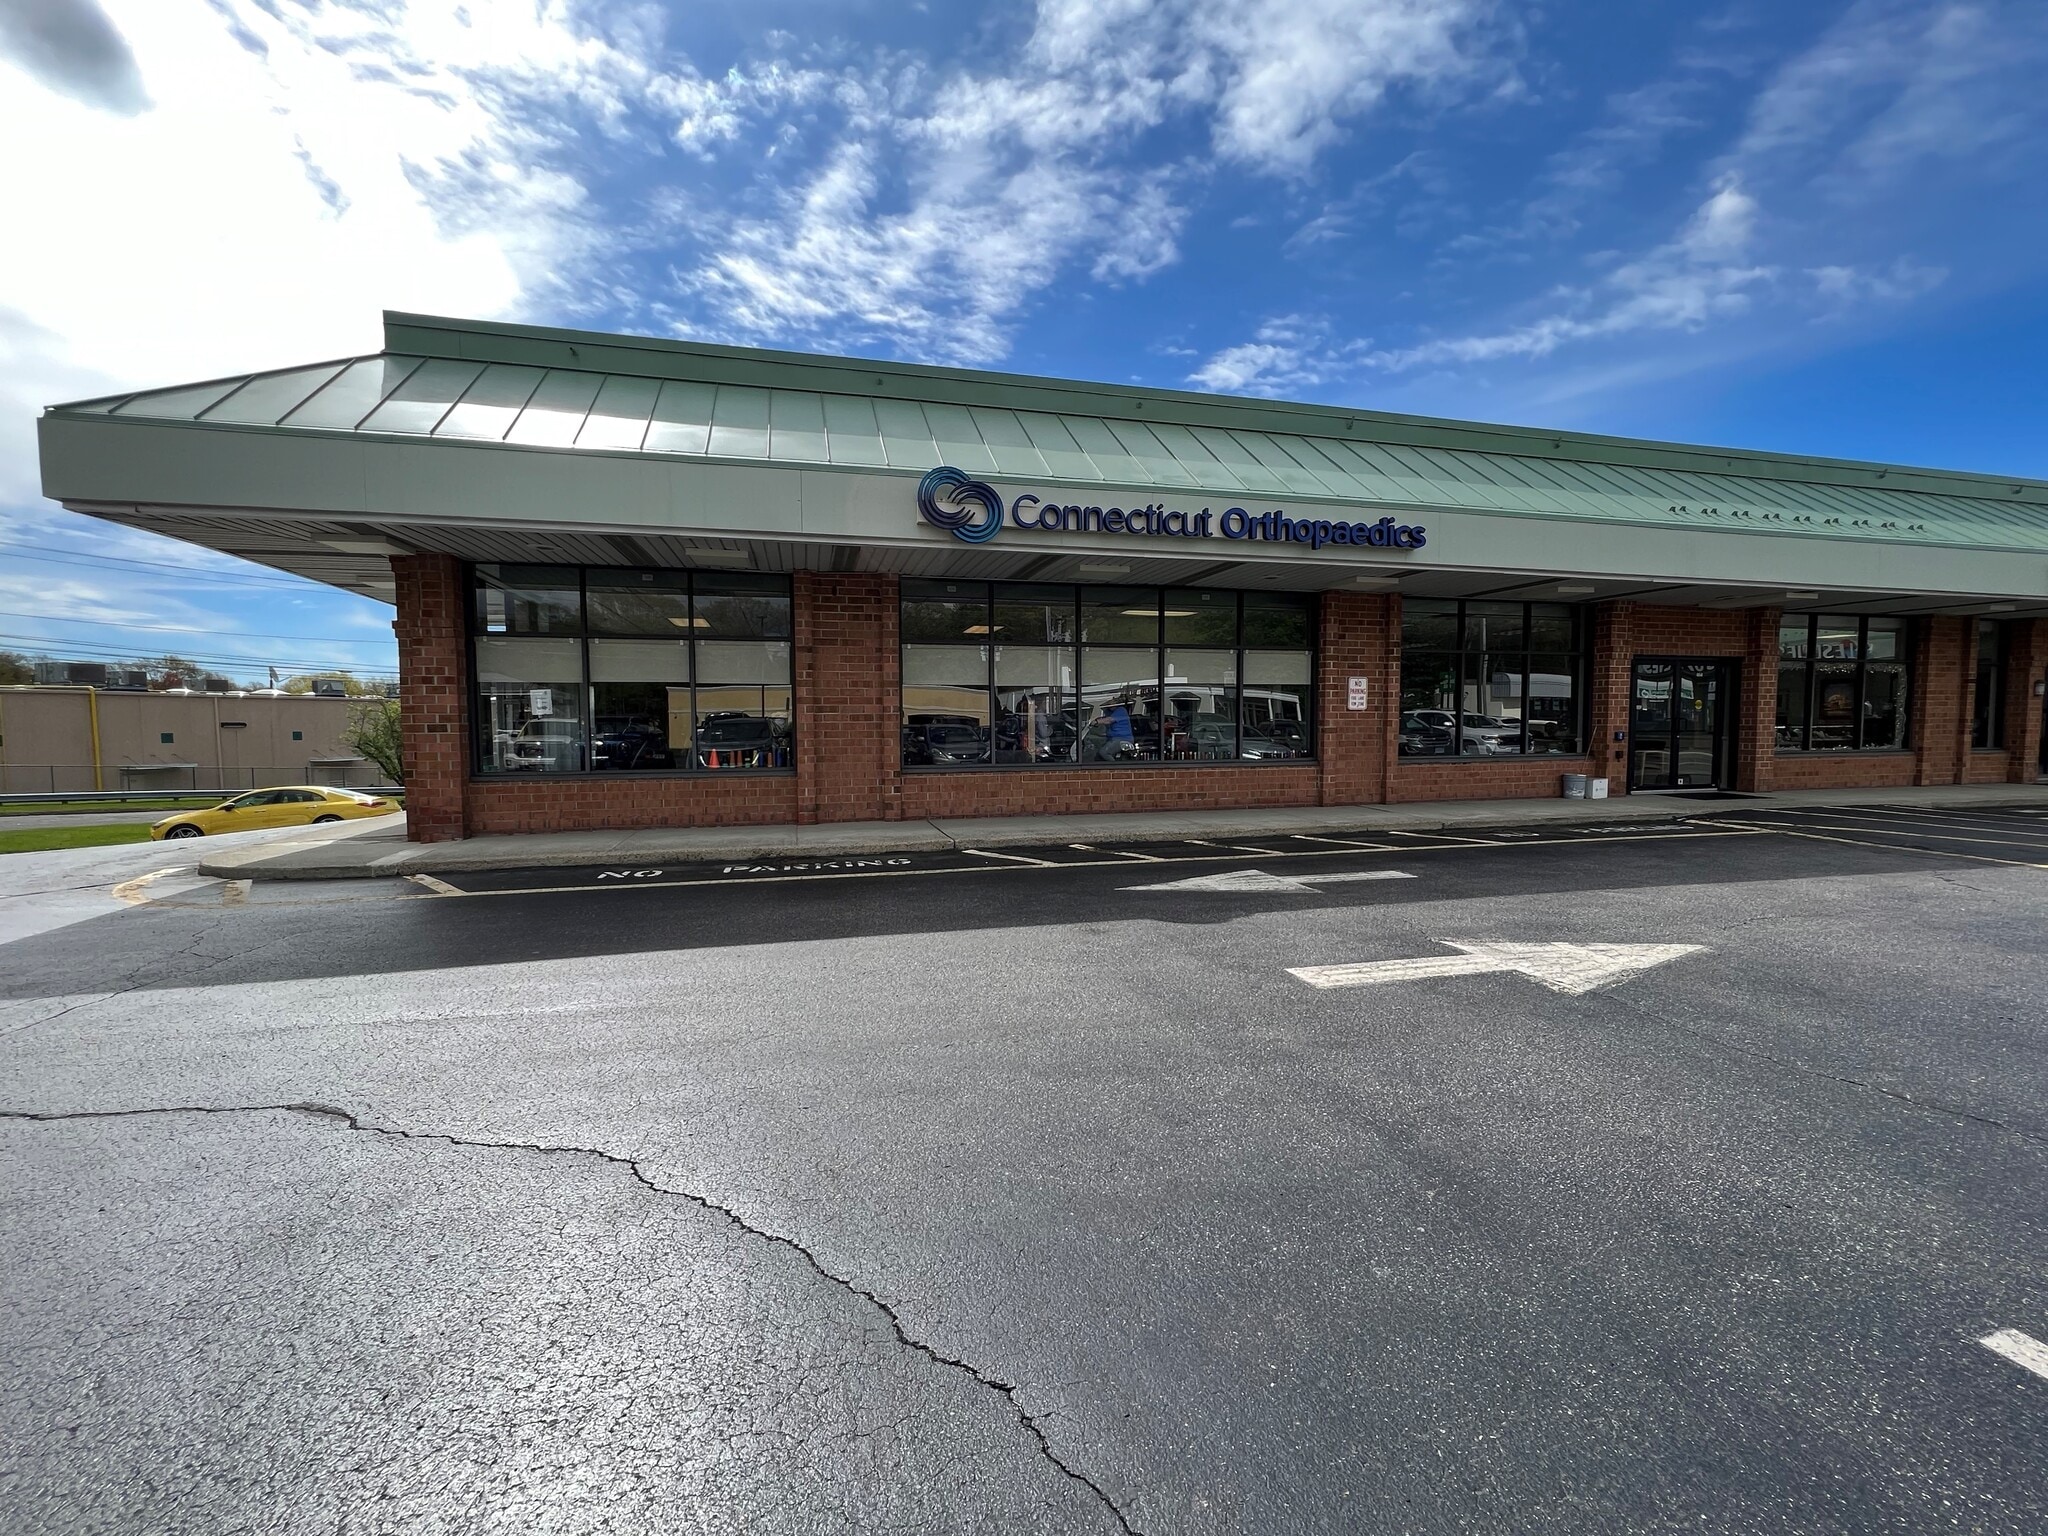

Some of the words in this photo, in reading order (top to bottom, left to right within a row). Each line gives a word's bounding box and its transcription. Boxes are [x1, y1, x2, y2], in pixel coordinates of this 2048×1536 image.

[1012, 494, 1213, 537] Connecticut
[1220, 507, 1426, 550] Orthopaedics
[597, 870, 663, 879] NO
[723, 858, 912, 873] PARKING
